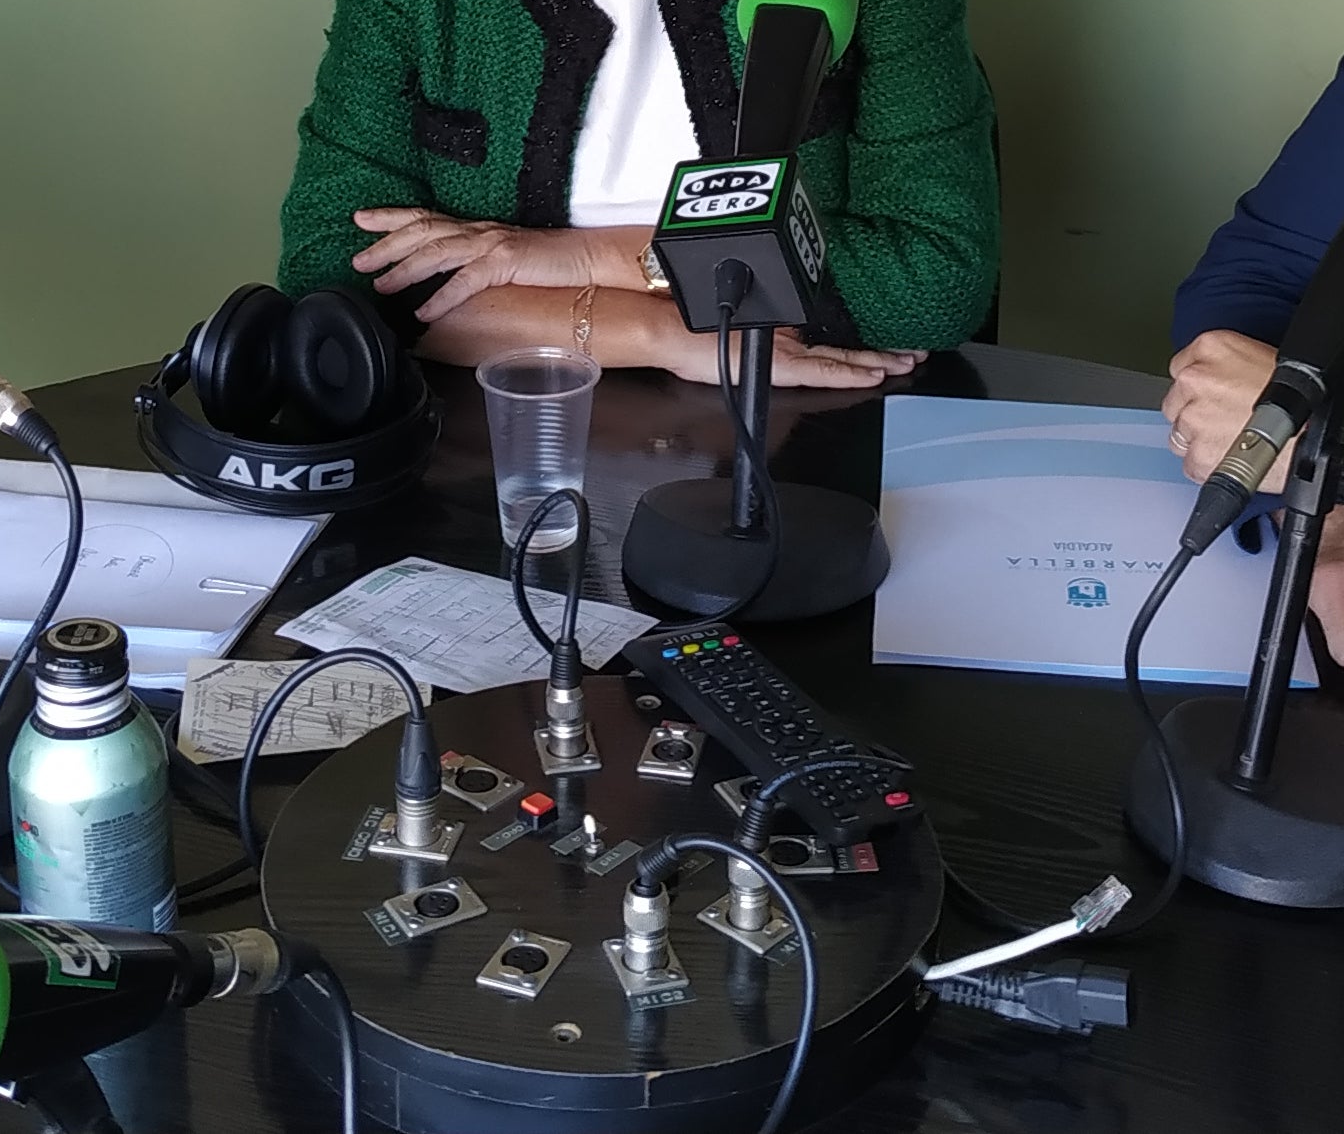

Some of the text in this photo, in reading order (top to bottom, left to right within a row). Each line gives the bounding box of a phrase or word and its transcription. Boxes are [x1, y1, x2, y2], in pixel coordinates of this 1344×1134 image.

[693, 175, 762, 195] ONDA
[689, 196, 757, 214] CERO
[796, 197, 822, 261] ONDA
[791, 221, 818, 282] CERO
[217, 454, 355, 492] AKG
[1006, 556, 1164, 570] MARBELLA
[373, 911, 401, 939] MIC1
[636, 990, 686, 1007] MIC2
